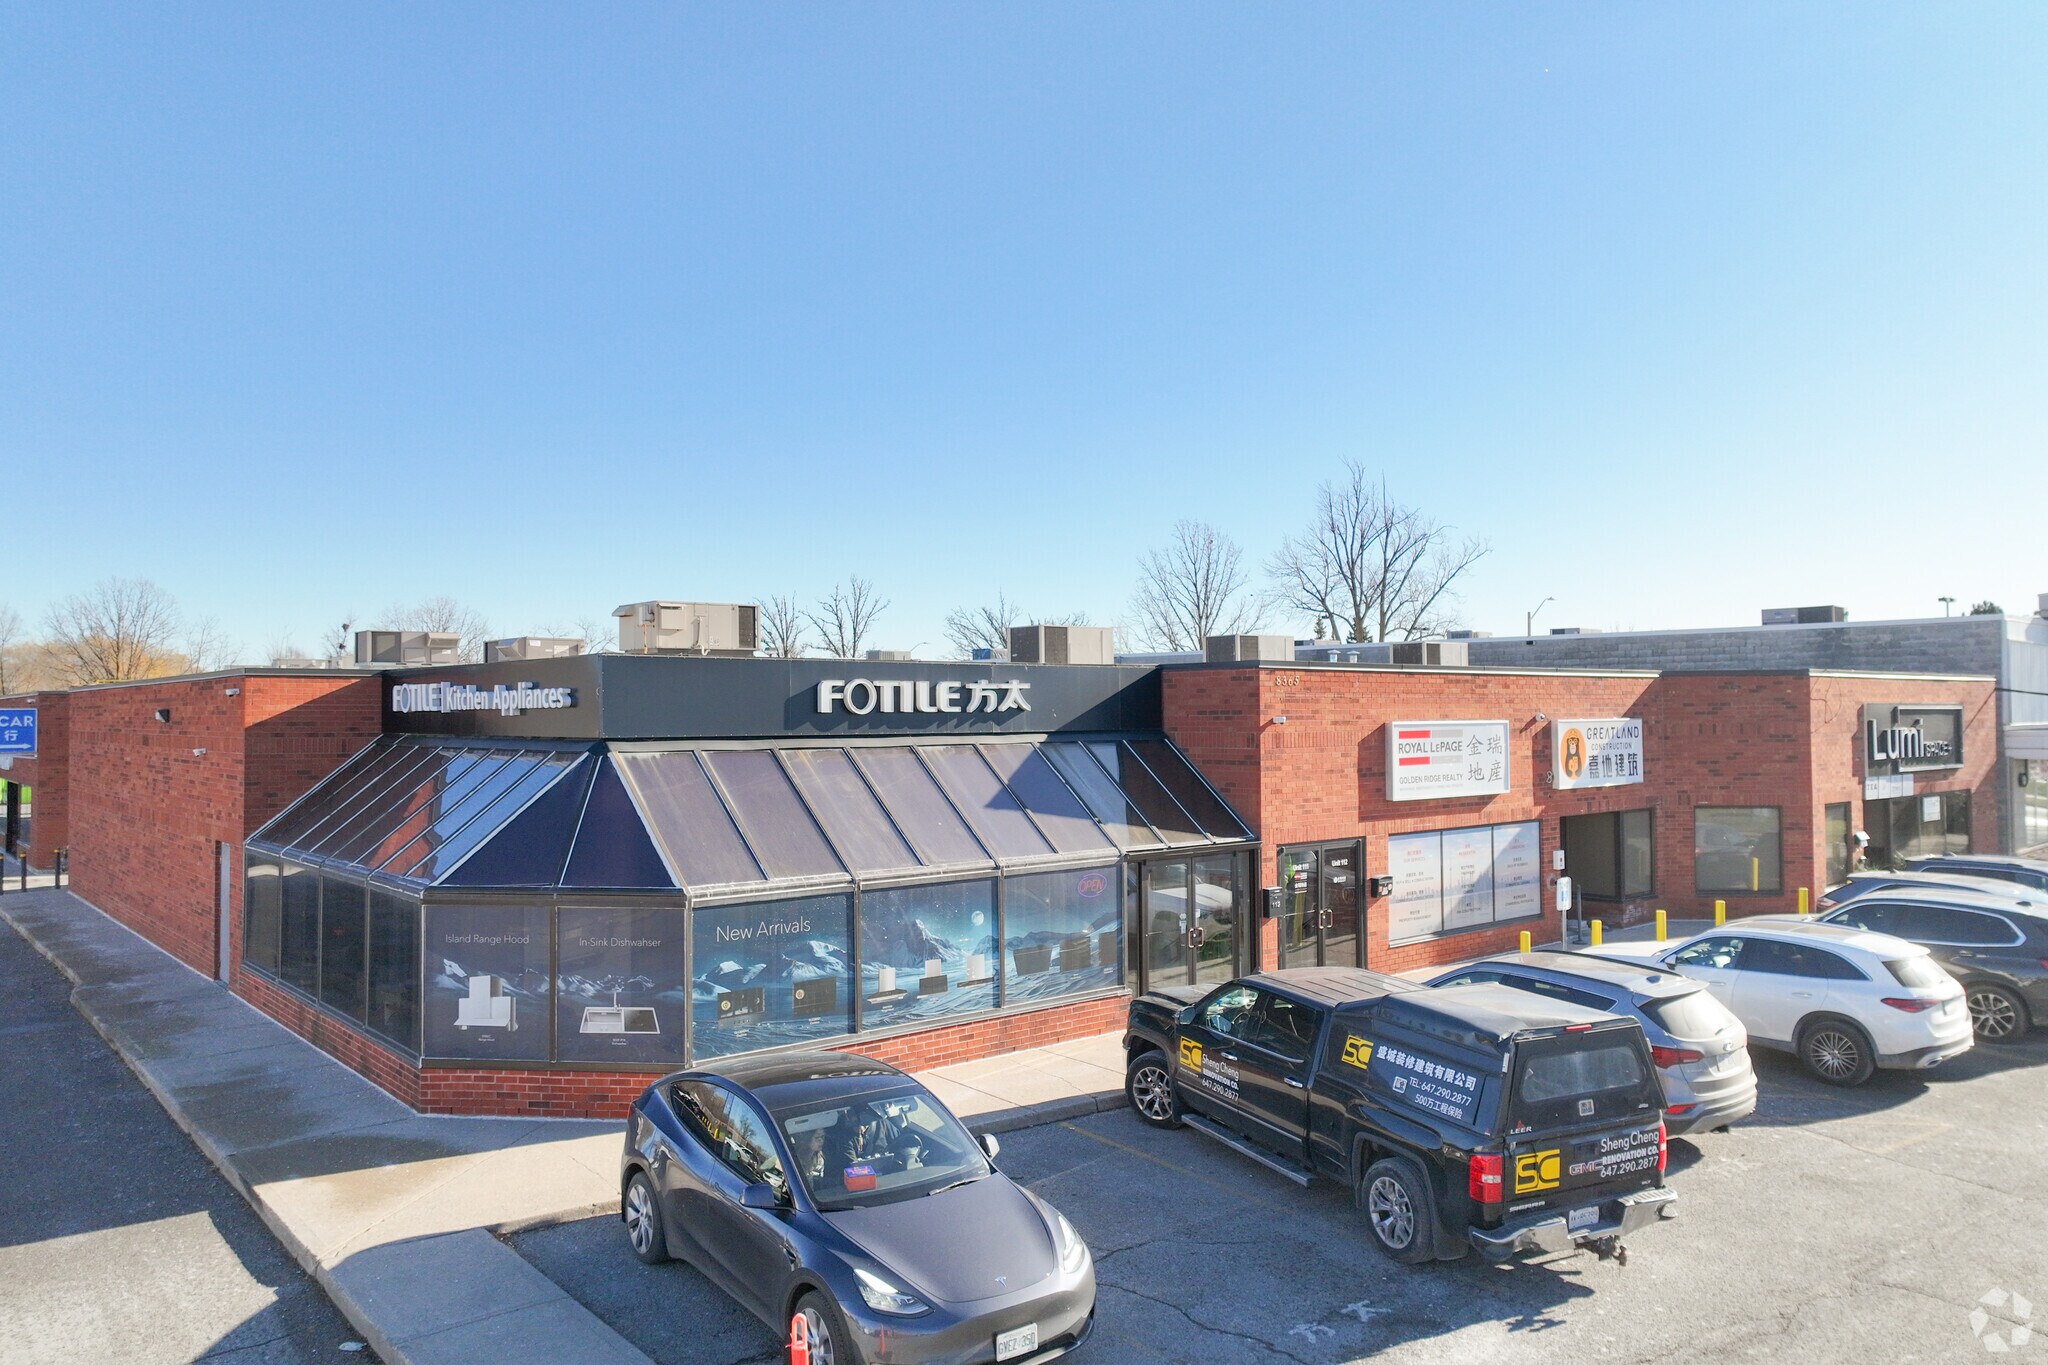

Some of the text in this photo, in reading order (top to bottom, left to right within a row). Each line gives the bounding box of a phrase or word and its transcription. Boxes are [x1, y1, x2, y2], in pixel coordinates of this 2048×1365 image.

[1275, 675, 1300, 686] 8365
[392, 681, 571, 717] FOTILE Kitchen Appliances
[816, 678, 962, 716] FOTILE
[965, 679, 1032, 714] 方太
[1586, 726, 1640, 740] GREATLAND
[1873, 718, 1924, 761] Lumi
[1398, 742, 1428, 754] ROYAL
[1466, 734, 1503, 756] 金瑞
[1591, 742, 1632, 751] CONSTRUCTION
[1399, 773, 1464, 785] GOLDEN RIDGE REALTY
[1080, 880, 1104, 892] OPEN
[445, 934, 530, 946] Island Range Hood
[716, 916, 811, 943] New Arrivals
[579, 937, 608, 947] In-Sink
[1202, 1053, 1220, 1073] Sheng
[1220, 1061, 1240, 1082] Cheng
[1201, 1078, 1240, 1102] 647.290.2877
[1202, 1068, 1231, 1087] RENOVATION
[1230, 1080, 1240, 1091] CO.
[1510, 1126, 1532, 1135] LEER
[1601, 1130, 1660, 1153] Sheng Cheng
[1602, 1145, 1659, 1166] RENOVATION CO.
[1569, 1159, 1603, 1176] GMC
[1600, 1156, 1659, 1178] 647.290.2877
